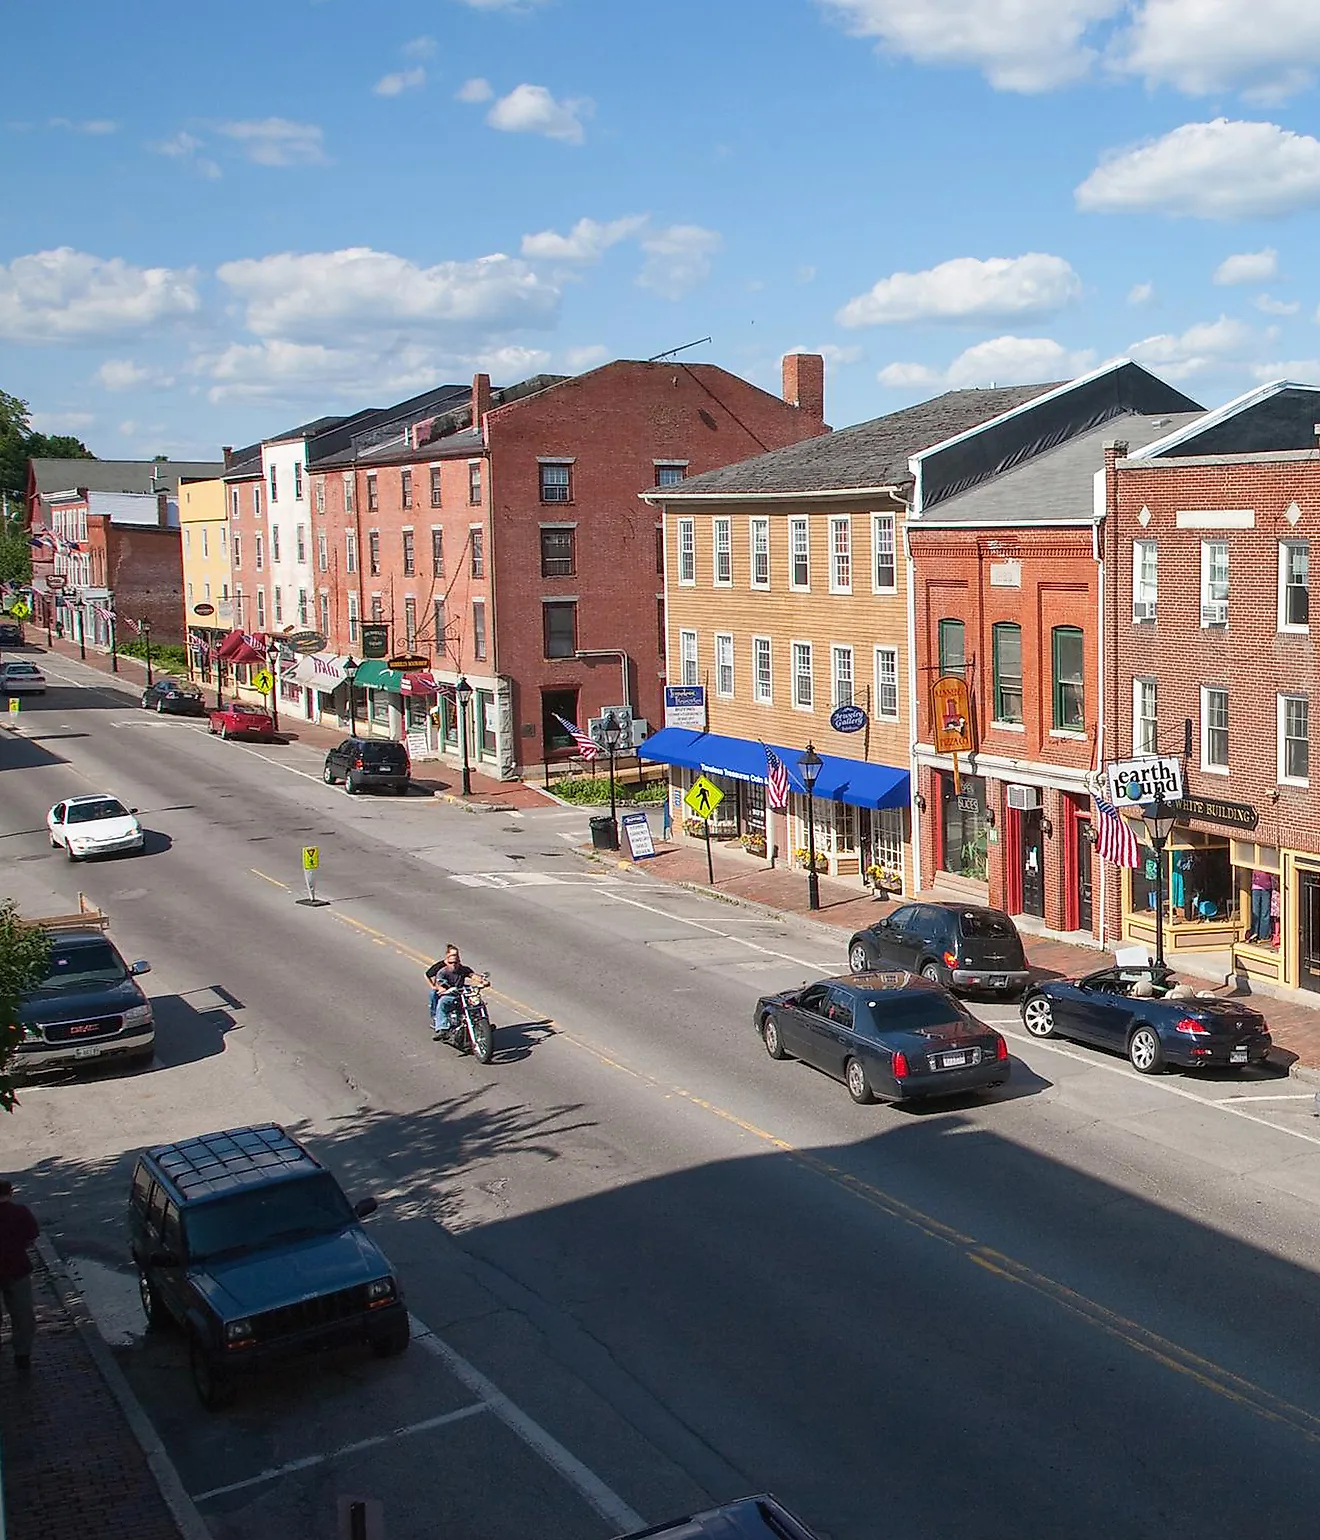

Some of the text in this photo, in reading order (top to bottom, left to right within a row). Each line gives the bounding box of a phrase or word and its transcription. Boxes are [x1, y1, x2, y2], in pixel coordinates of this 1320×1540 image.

[833, 710, 864, 721] Jewelry
[835, 719, 864, 729] Gallery
[1118, 760, 1171, 783] earth
[1174, 799, 1204, 814] WHITE
[1206, 804, 1250, 823] BUILDING
